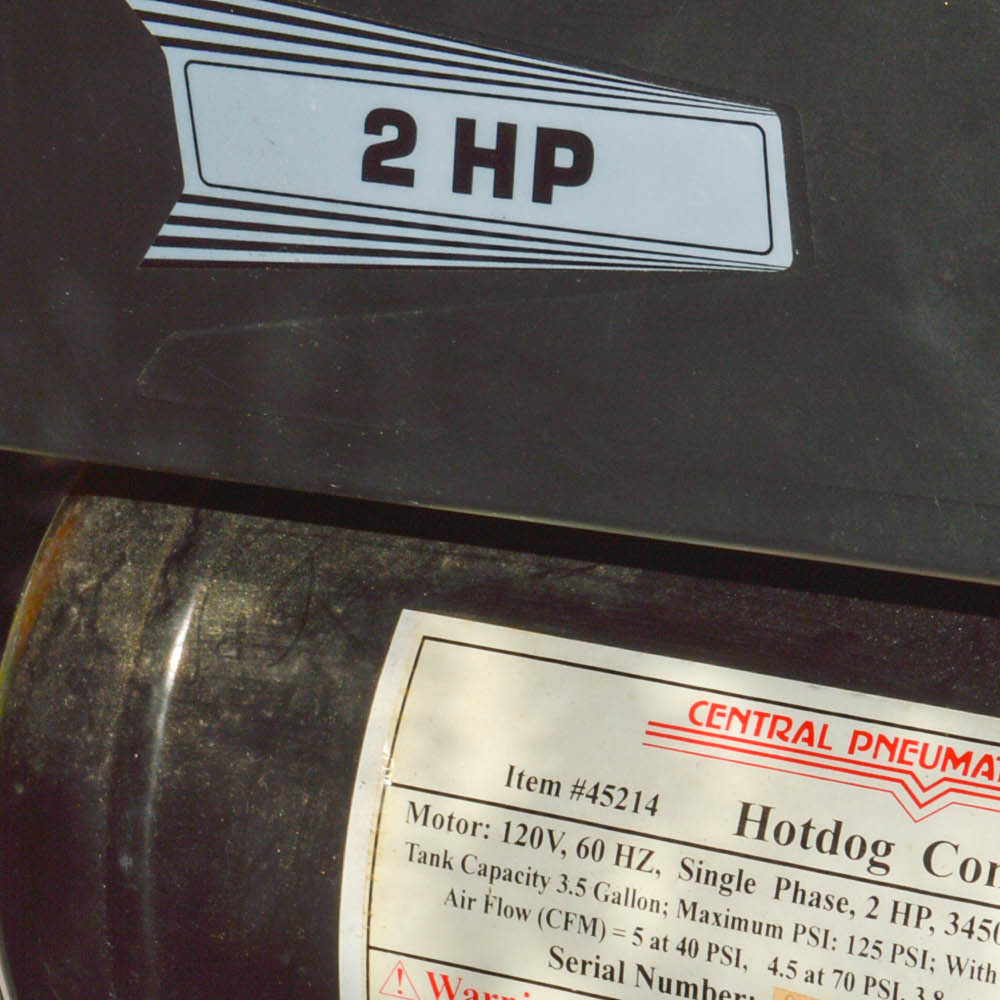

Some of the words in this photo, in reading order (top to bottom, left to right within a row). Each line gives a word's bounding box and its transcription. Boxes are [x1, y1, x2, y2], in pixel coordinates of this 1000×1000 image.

[361, 107, 418, 188] 2
[452, 117, 595, 205] HP
[688, 700, 833, 751] CENTRAL
[504, 764, 562, 799] Item
[569, 777, 660, 817] #45214
[405, 800, 491, 840] Motor:
[501, 820, 567, 860] 120V,
[575, 836, 606, 863] 60
[613, 842, 661, 879] HZ,
[677, 856, 757, 898] Single
[773, 875, 856, 921] Phase,
[864, 895, 880, 921] 2
[889, 899, 935, 937] HP,
[732, 801, 897, 877] Hotdog
[405, 841, 454, 871] Tank
[460, 853, 551, 896] Capacity
[555, 873, 588, 898] 3.5
[593, 881, 669, 917] Gallon;
[676, 897, 784, 941] Maximum
[792, 922, 837, 951] PSI:
[847, 935, 884, 961] 125
[889, 943, 936, 975] PSI;
[945, 953, 997, 985] With
[443, 887, 478, 911] Air
[483, 893, 532, 923] Flow
[537, 907, 607, 944] (CFM)
[612, 928, 626, 938] =
[631, 926, 644, 947] 5
[649, 935, 669, 953] at
[675, 936, 700, 959] 40
[705, 941, 748, 973] PSI,
[767, 955, 799, 980] 4.5
[803, 967, 825, 987] at
[832, 968, 856, 993] 70
[547, 945, 625, 985] Serial
